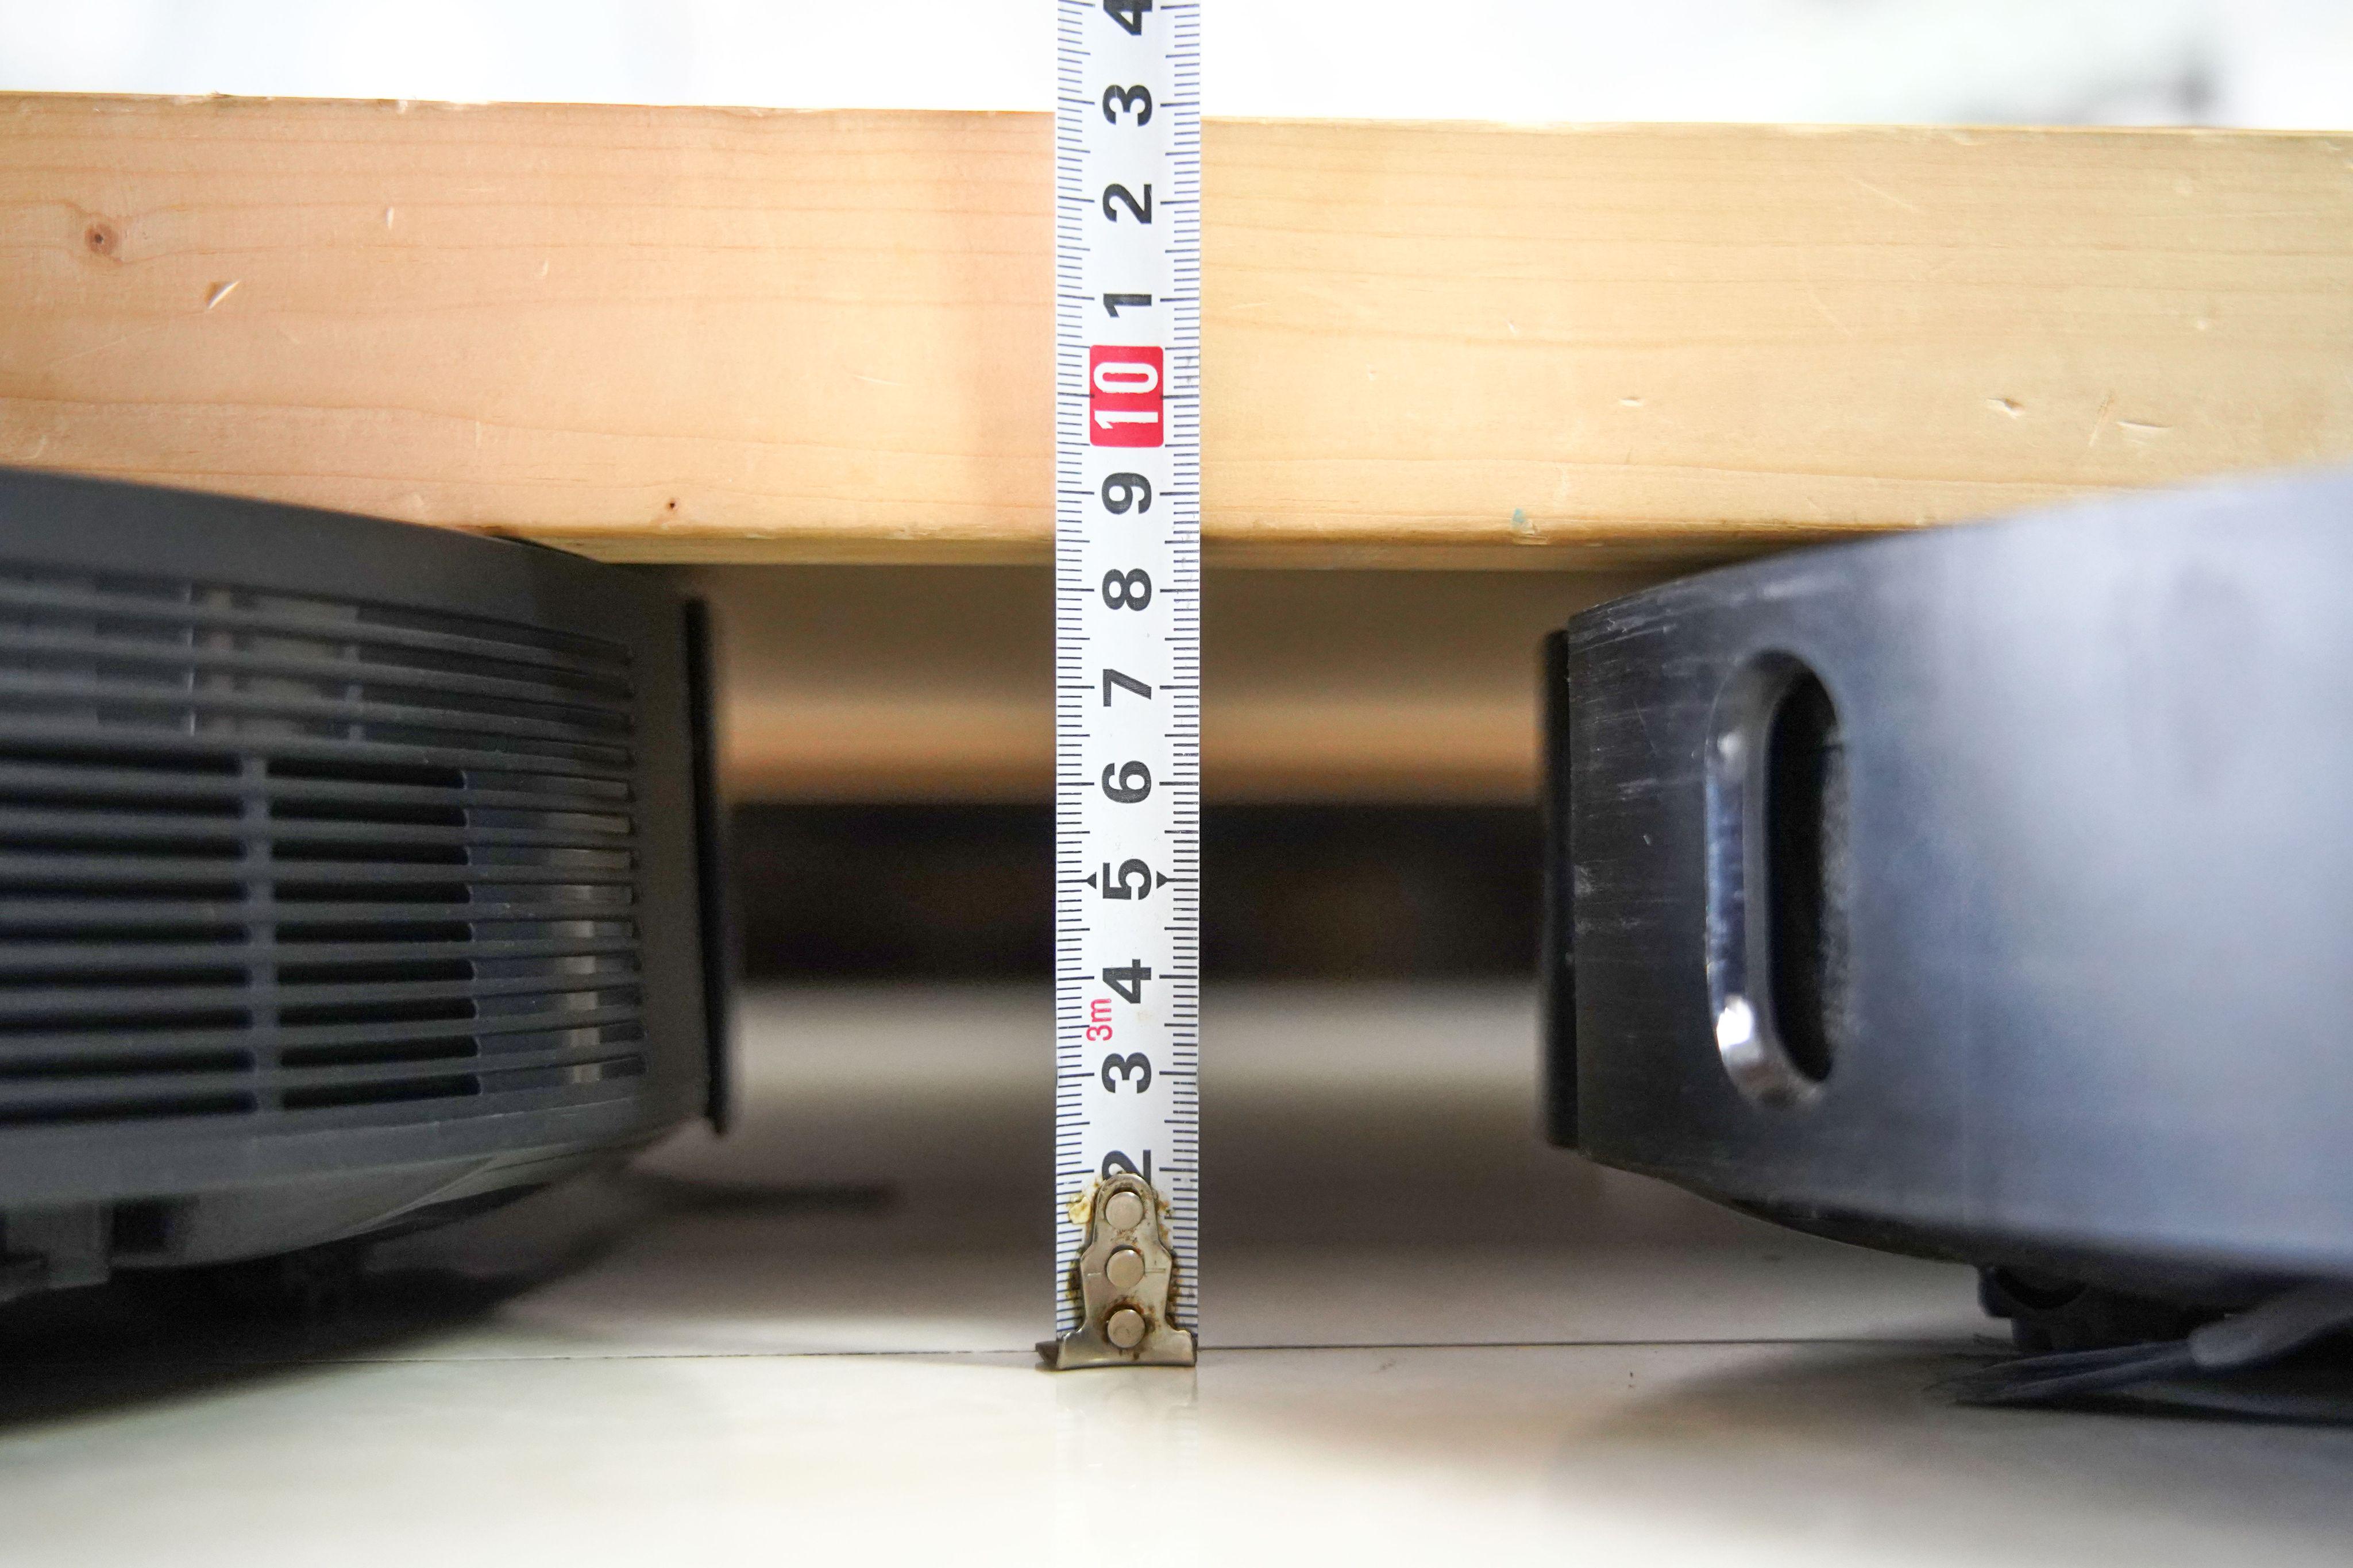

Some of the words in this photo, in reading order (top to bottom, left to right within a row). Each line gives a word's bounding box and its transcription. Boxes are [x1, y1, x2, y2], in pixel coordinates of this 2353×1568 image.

[1103, 0, 1152, 36] 4
[1102, 84, 1152, 126] 3
[1102, 184, 1152, 224] 2
[1103, 293, 1152, 318] 1
[1093, 361, 1159, 430] 10
[1101, 472, 1152, 515] 9
[1102, 568, 1152, 611] 8
[1102, 669, 1152, 707] 7
[1102, 760, 1152, 804] 6
[1102, 859, 1152, 900] 5
[1102, 959, 1152, 1004] 4
[1086, 998, 1113, 1041] 3m
[1101, 1052, 1152, 1094] 3
